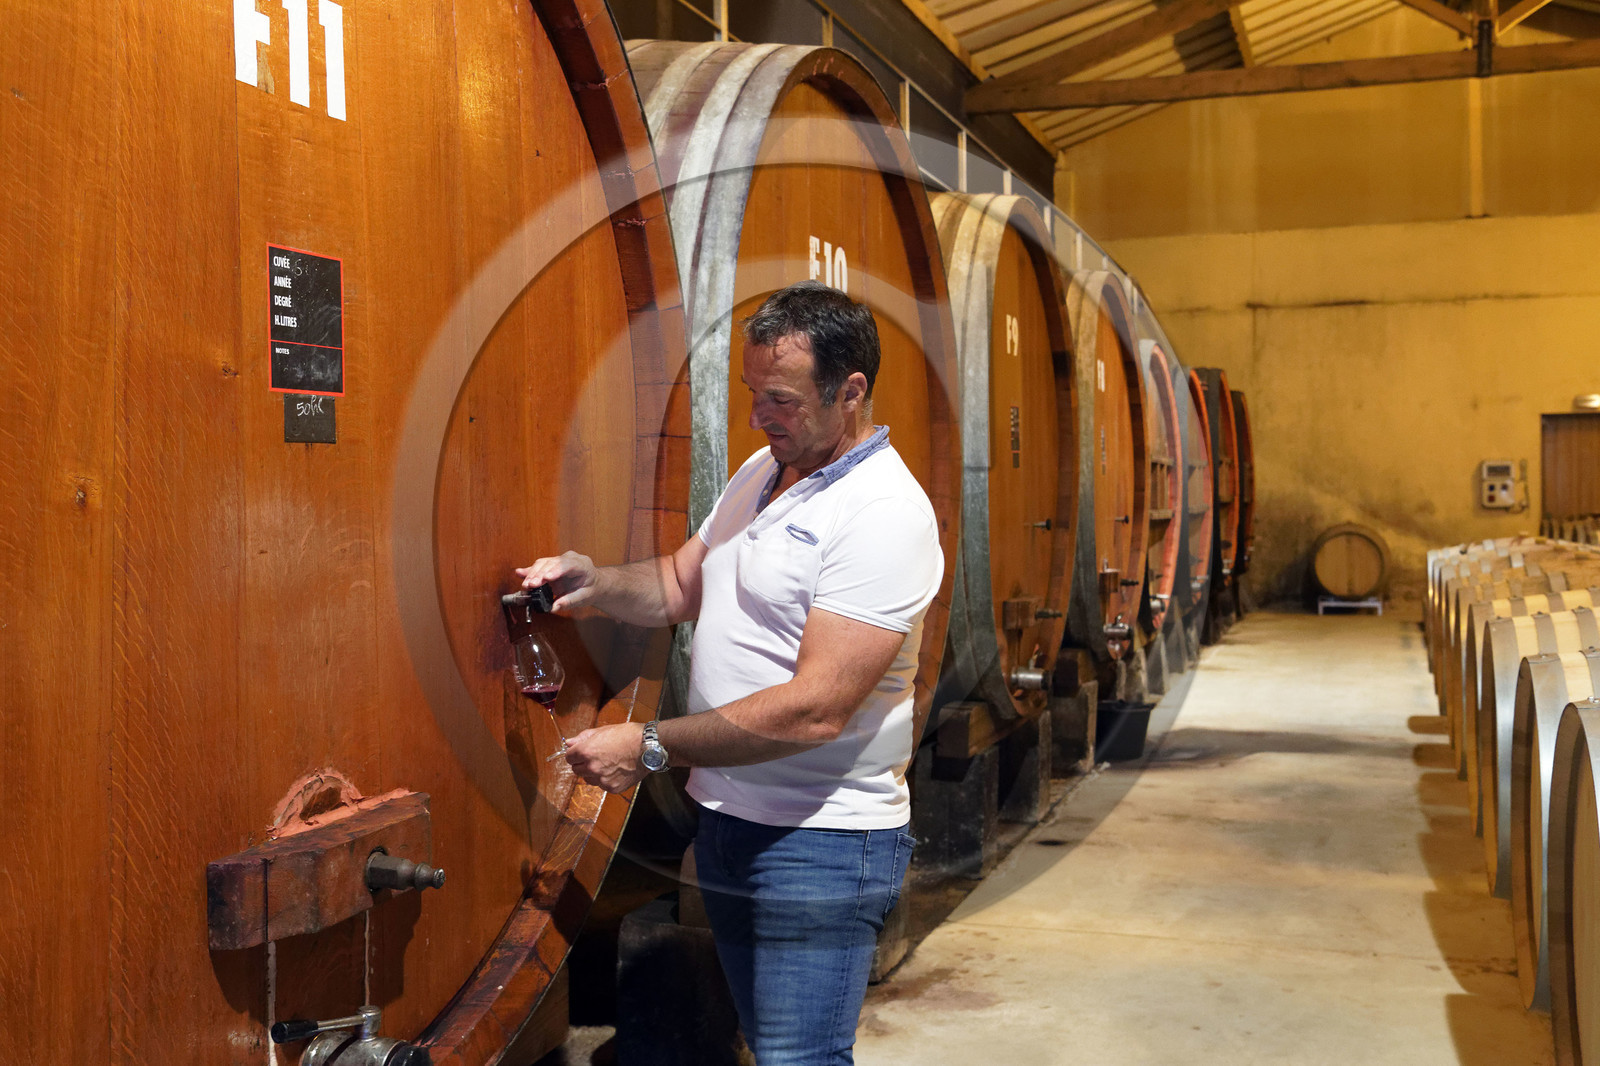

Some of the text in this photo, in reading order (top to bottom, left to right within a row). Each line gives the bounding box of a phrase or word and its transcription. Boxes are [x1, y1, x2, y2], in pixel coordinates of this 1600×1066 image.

[233, 0, 347, 122] F11
[273, 255, 291, 269] CUVÉE
[809, 235, 848, 294] F10
[273, 275, 292, 289] ANNÉE
[274, 294, 292, 308] DEGRÉ
[1006, 314, 1019, 357] F9
[275, 347, 290, 355] NOTES
